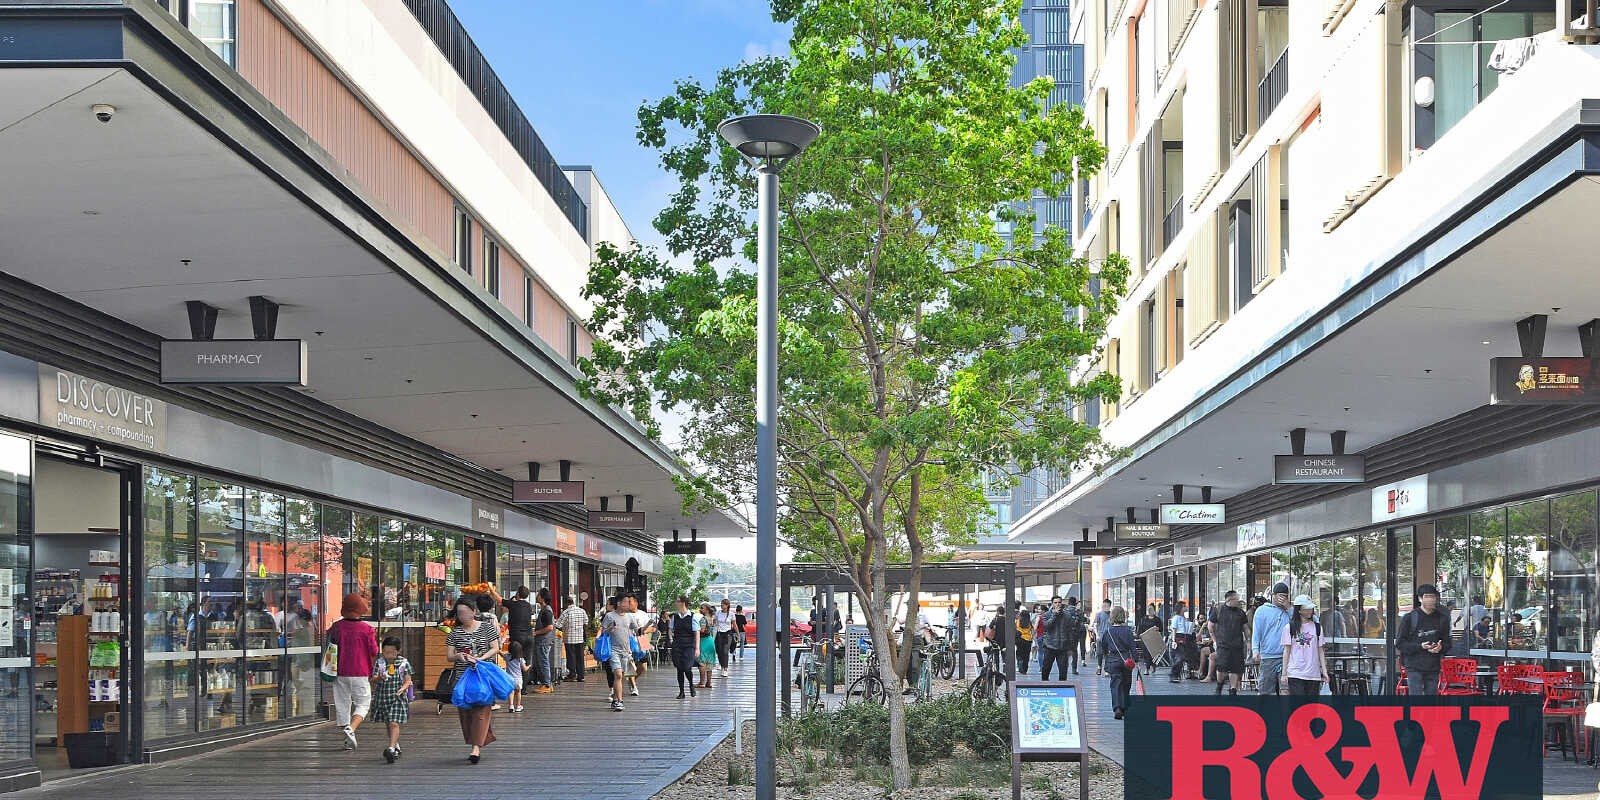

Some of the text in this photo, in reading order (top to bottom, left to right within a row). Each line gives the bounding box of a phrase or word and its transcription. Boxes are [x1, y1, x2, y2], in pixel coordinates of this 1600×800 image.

[197, 354, 262, 364] PHARMACY
[56, 371, 154, 427] DISCOVER
[57, 409, 96, 430] pharmacy
[107, 424, 154, 448] compounding
[1295, 468, 1344, 476] RESTAURANT
[1178, 509, 1217, 519] Chatime
